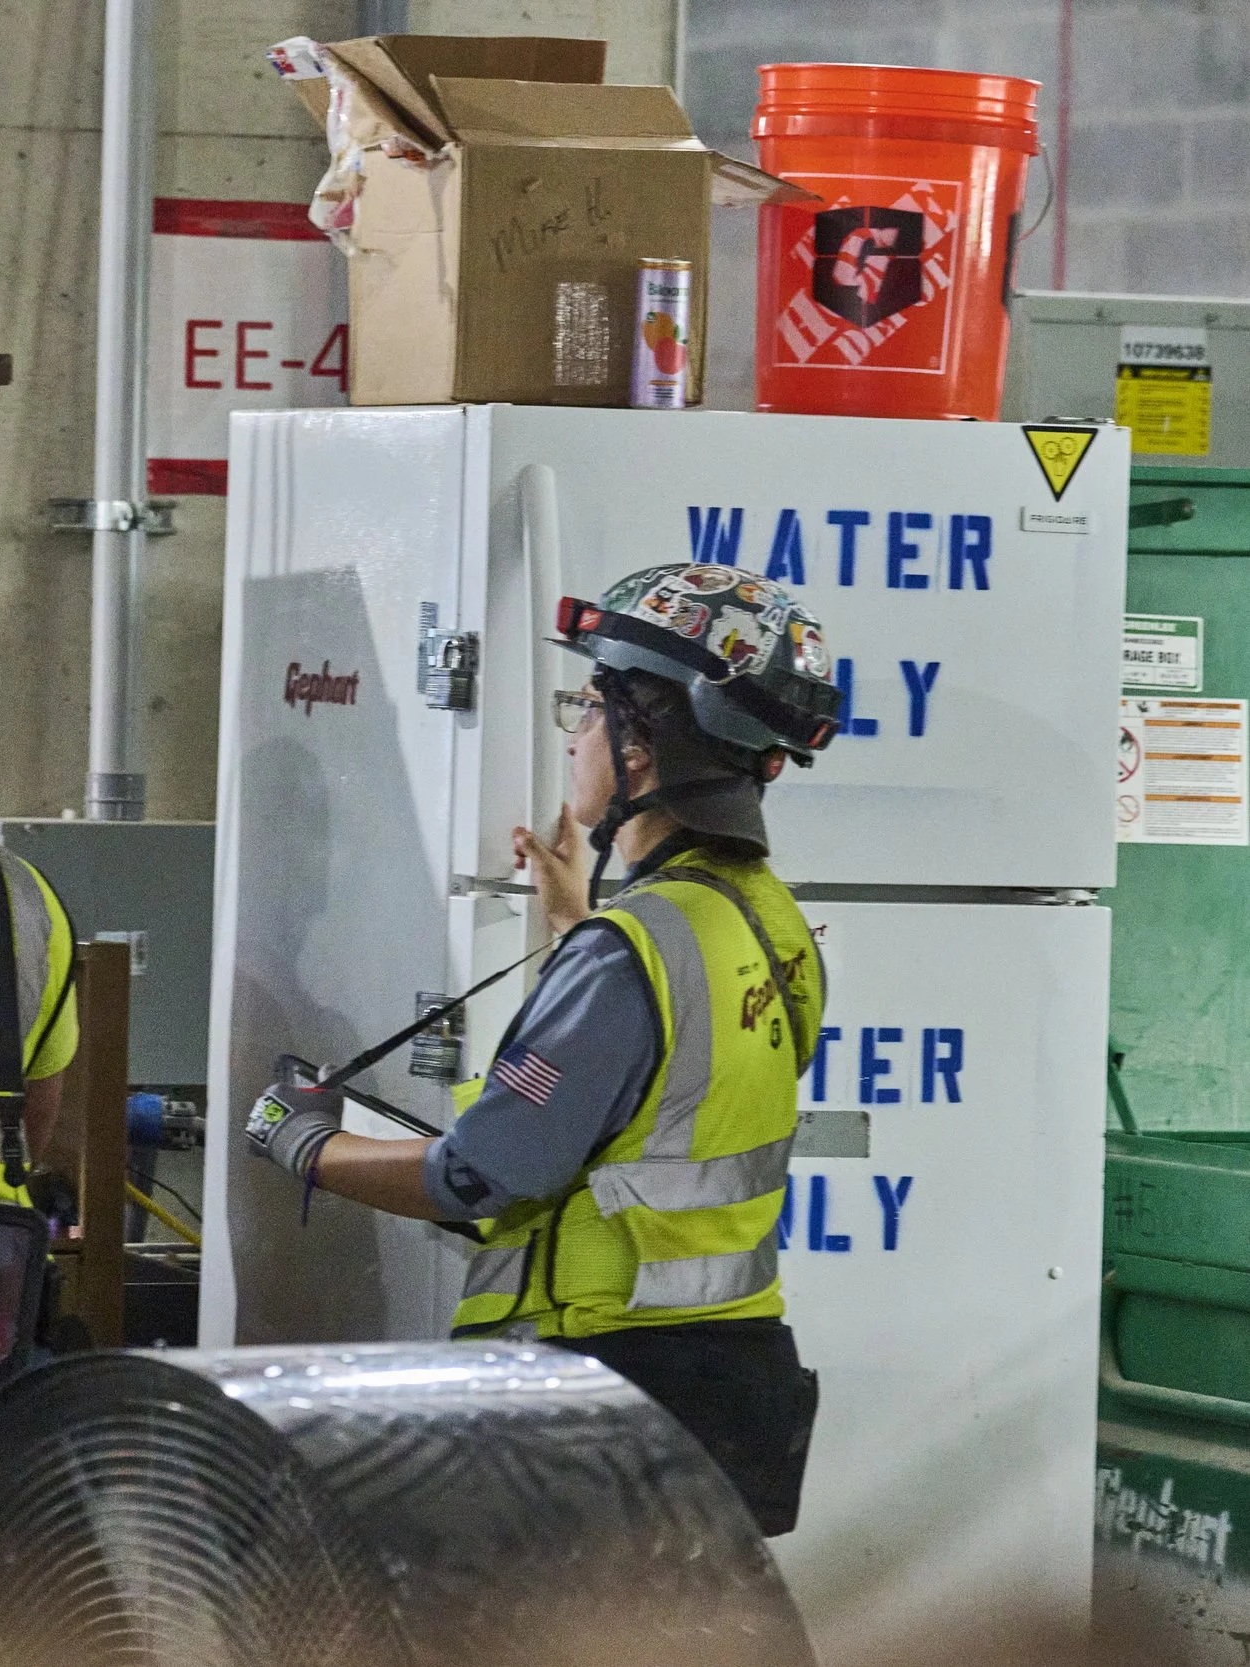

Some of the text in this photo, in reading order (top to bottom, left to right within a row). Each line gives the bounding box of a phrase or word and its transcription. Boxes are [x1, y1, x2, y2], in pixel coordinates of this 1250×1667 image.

[185, 320, 349, 393] EE-4
[687, 505, 993, 591] WATER
[284, 659, 360, 718] Gephart
[1123, 649, 1154, 663] RAGE
[835, 657, 942, 737] LY
[811, 1026, 964, 1104] TER
